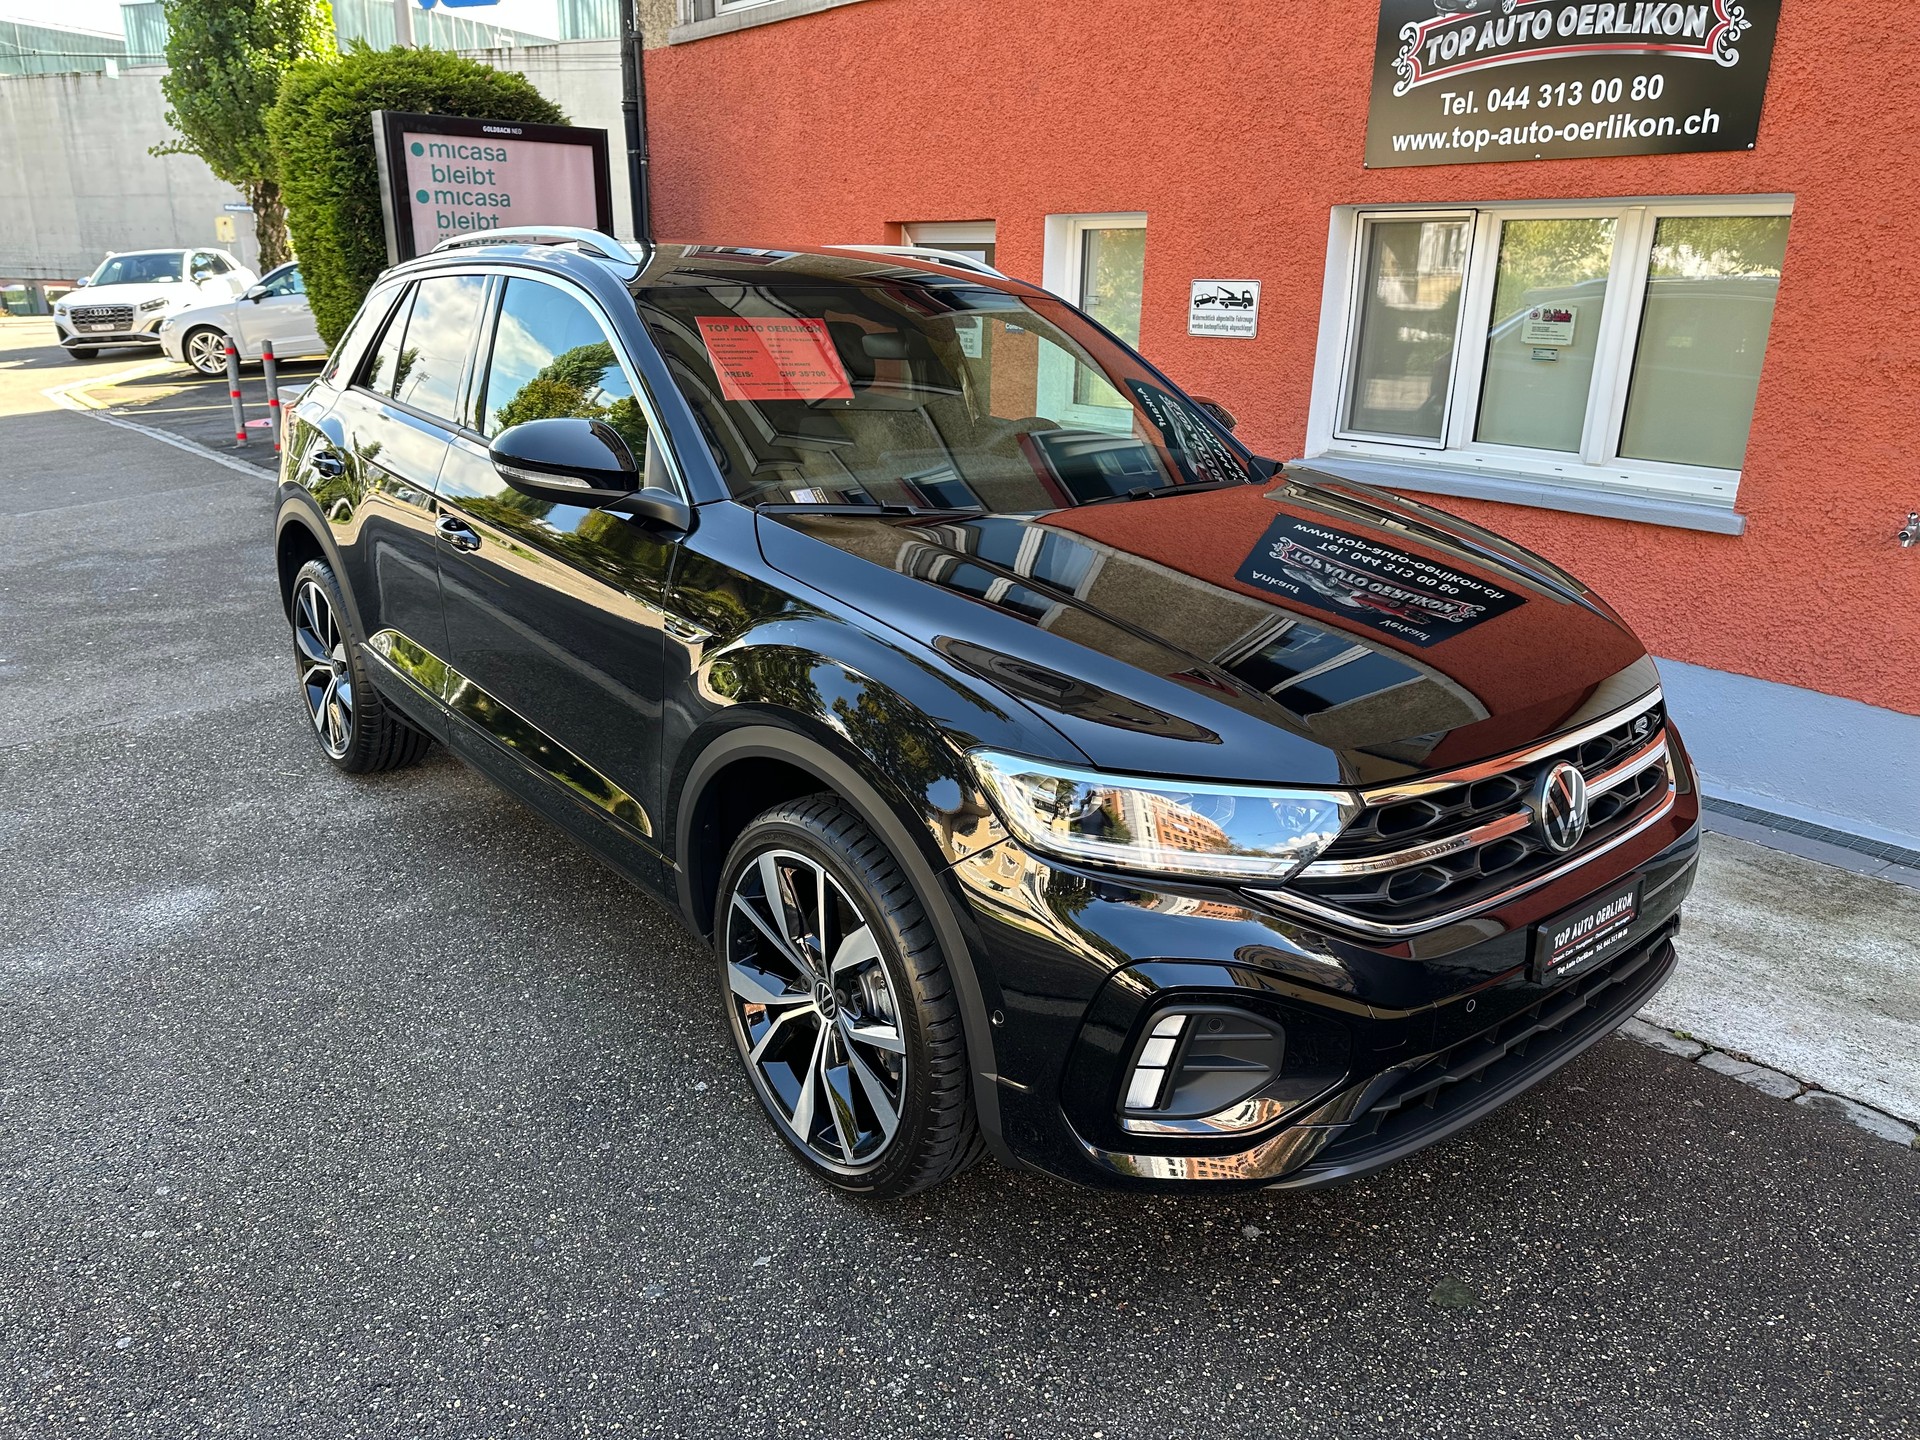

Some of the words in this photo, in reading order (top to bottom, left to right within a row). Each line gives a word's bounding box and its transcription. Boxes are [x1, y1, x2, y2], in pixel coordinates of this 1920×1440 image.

[1425, 26, 1476, 66] TOP
[1476, 10, 1553, 53] AUTO
[1557, 2, 1710, 39] OERLIKON
[1440, 91, 1479, 117] Tel.
[1487, 85, 1530, 113] 044
[1537, 81, 1583, 109] 313
[1590, 77, 1623, 104] 00
[1630, 74, 1665, 101] 80
[482, 125, 511, 134] GOLDBACH
[1392, 108, 1720, 152] www.top-auto-oerlikon.ch
[429, 142, 507, 162] micasa
[431, 164, 497, 186] bleibt
[434, 189, 511, 208] micasa
[436, 210, 500, 230] bleibt
[706, 324, 730, 333] TOP
[733, 324, 765, 333] AUTO
[767, 324, 823, 334] OERLIKON
[724, 370, 754, 378] PREIS:
[779, 370, 797, 378] CHF
[1554, 927, 1571, 949] TOP
[1571, 915, 1594, 940] AUTO
[1595, 892, 1633, 926] OERLIKON
